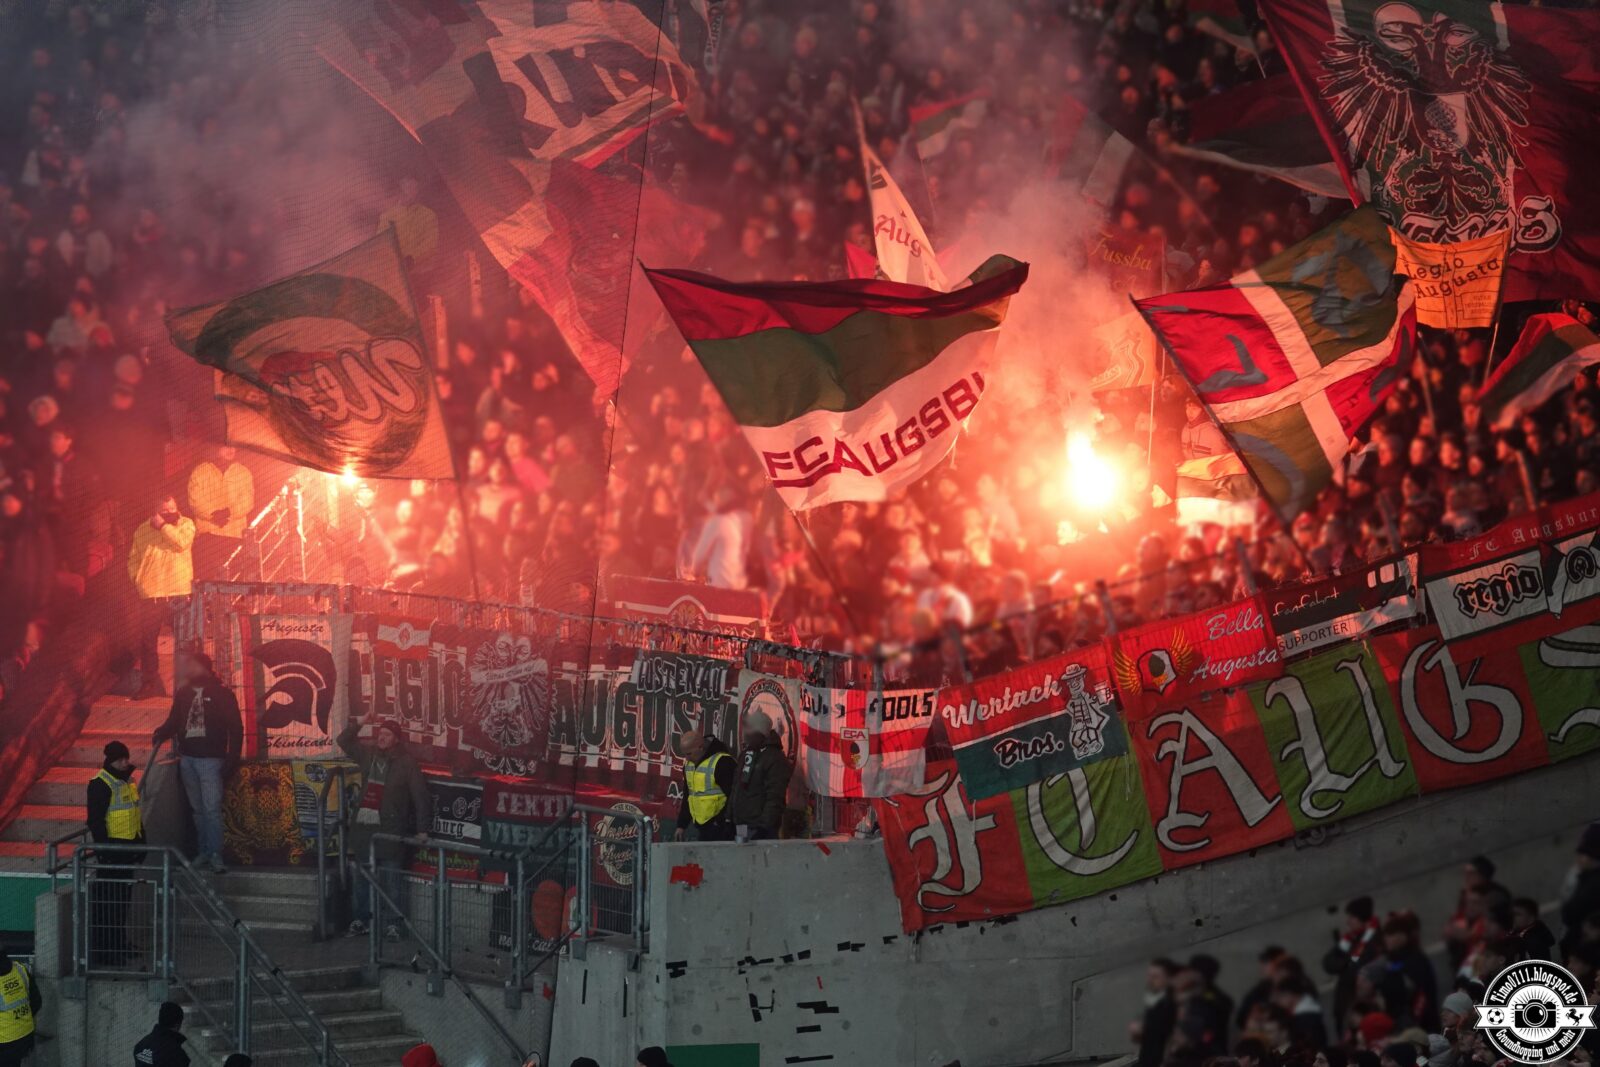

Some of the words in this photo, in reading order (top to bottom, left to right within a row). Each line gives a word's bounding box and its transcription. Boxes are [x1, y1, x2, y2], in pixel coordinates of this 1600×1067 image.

[1405, 256, 1465, 280] Legio
[1414, 256, 1501, 300] Augusta
[1469, 542, 1500, 560] FC
[1453, 562, 1544, 619] regio
[261, 619, 325, 635] Augusta
[1206, 608, 1265, 641] Bella
[1278, 622, 1349, 652] SUPPORTER
[1189, 647, 1279, 684] Augusta
[942, 674, 1062, 729] Wertach
[264, 733, 334, 748] Skinheads
[995, 732, 1065, 768] Bros.
